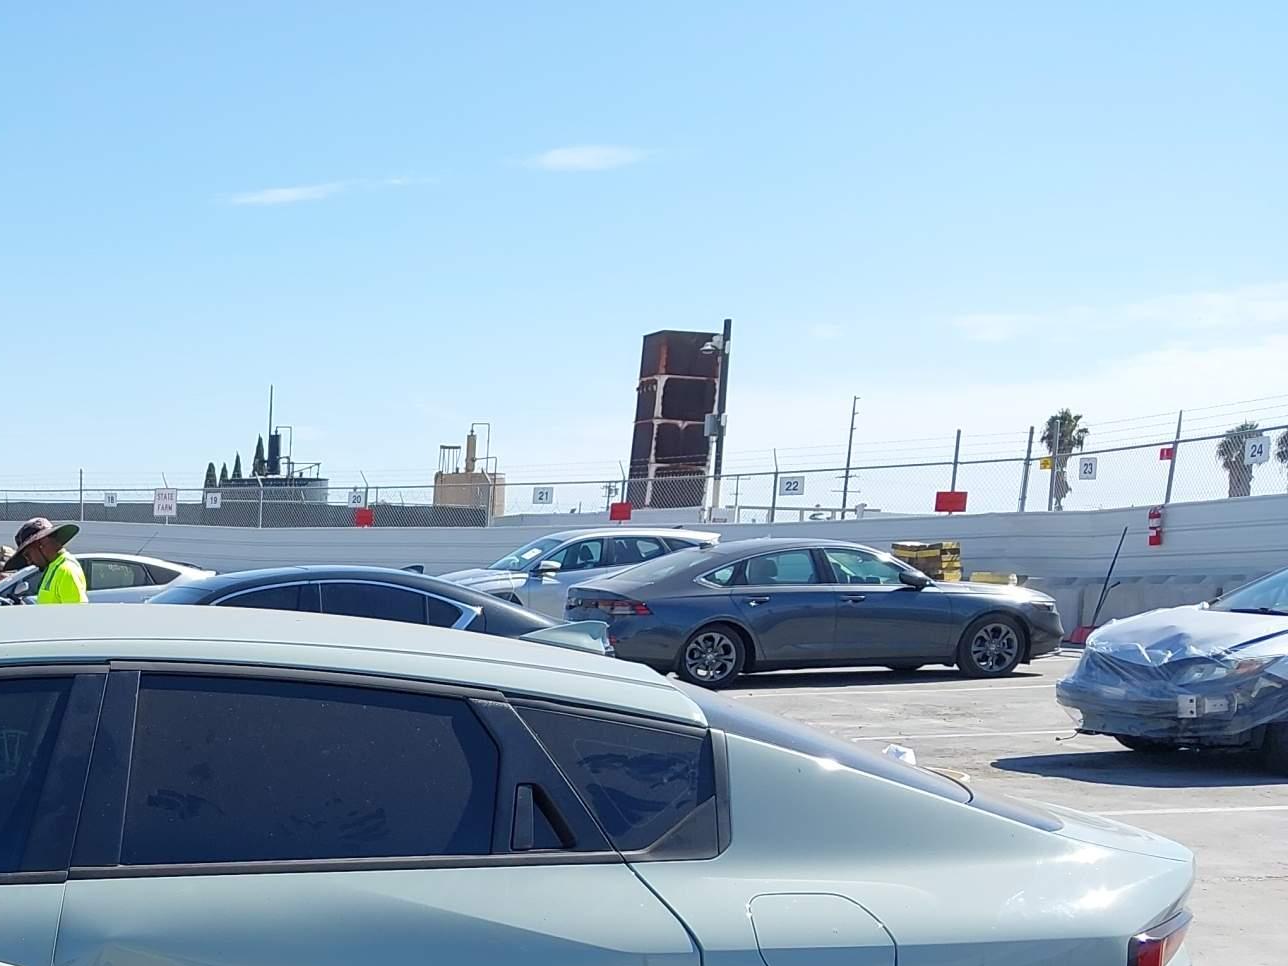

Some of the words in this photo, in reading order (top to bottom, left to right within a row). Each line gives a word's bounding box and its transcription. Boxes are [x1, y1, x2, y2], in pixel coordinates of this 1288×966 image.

[1250, 443, 1263, 458] 24
[1083, 462, 1093, 475] 23
[785, 480, 799, 491] 22
[157, 493, 174, 501] STATE
[210, 496, 218, 505] 19
[352, 494, 362, 504] 20
[538, 491, 549, 501] 21
